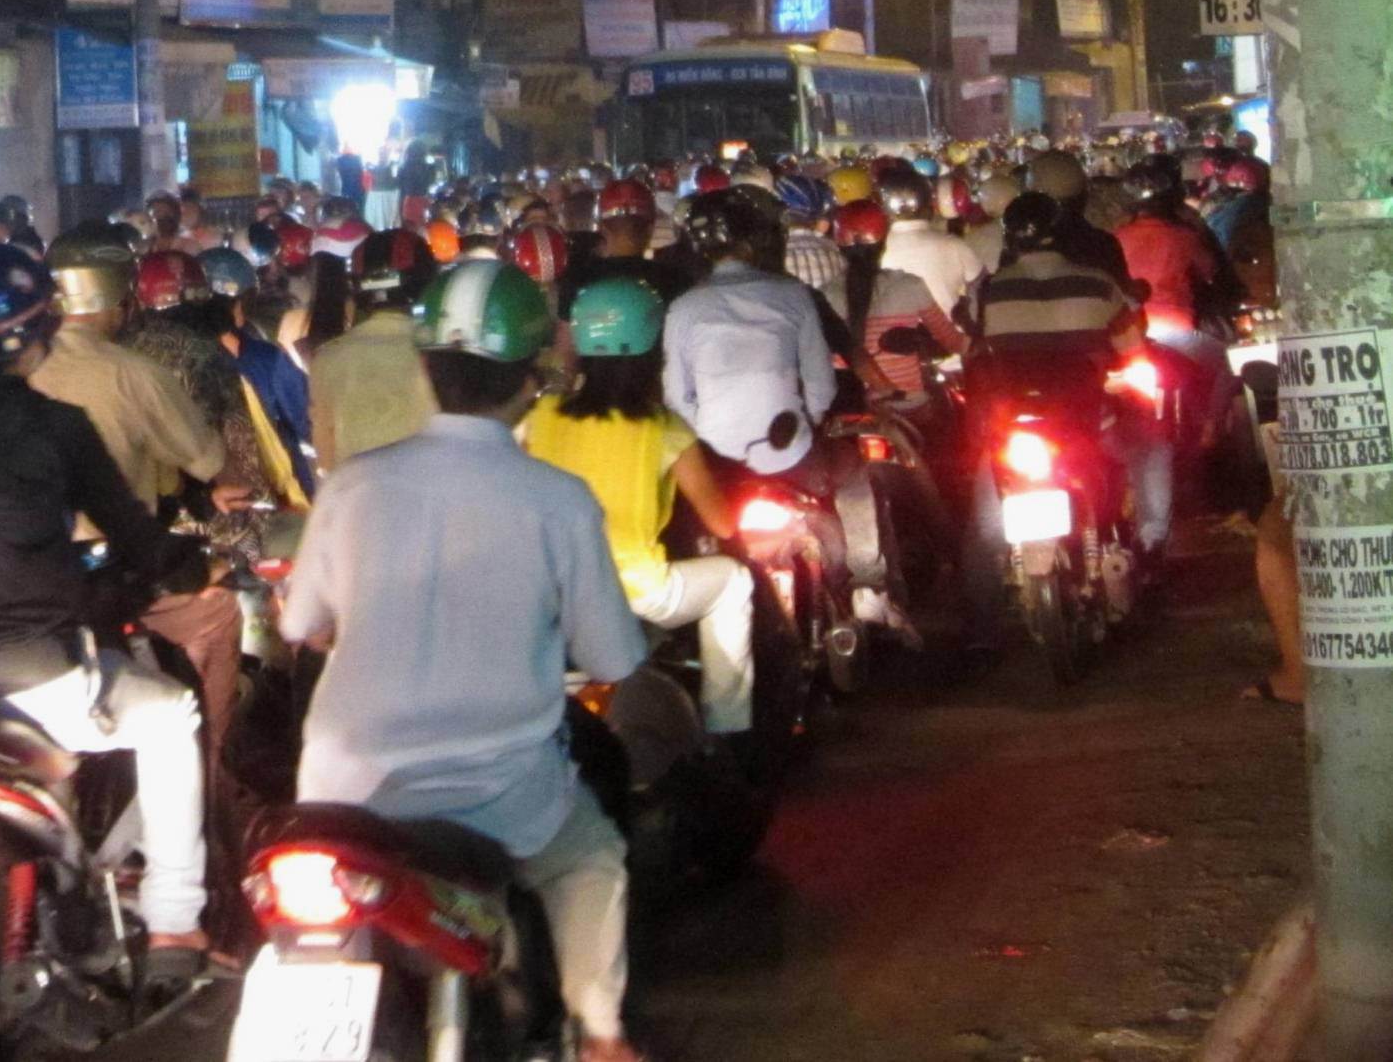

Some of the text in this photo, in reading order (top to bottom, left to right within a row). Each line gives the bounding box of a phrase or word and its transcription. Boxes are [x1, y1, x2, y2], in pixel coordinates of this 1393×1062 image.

[1311, 407, 1338, 430] 700
[1329, 538, 1358, 568] CHO
[1360, 532, 1393, 567] THU
